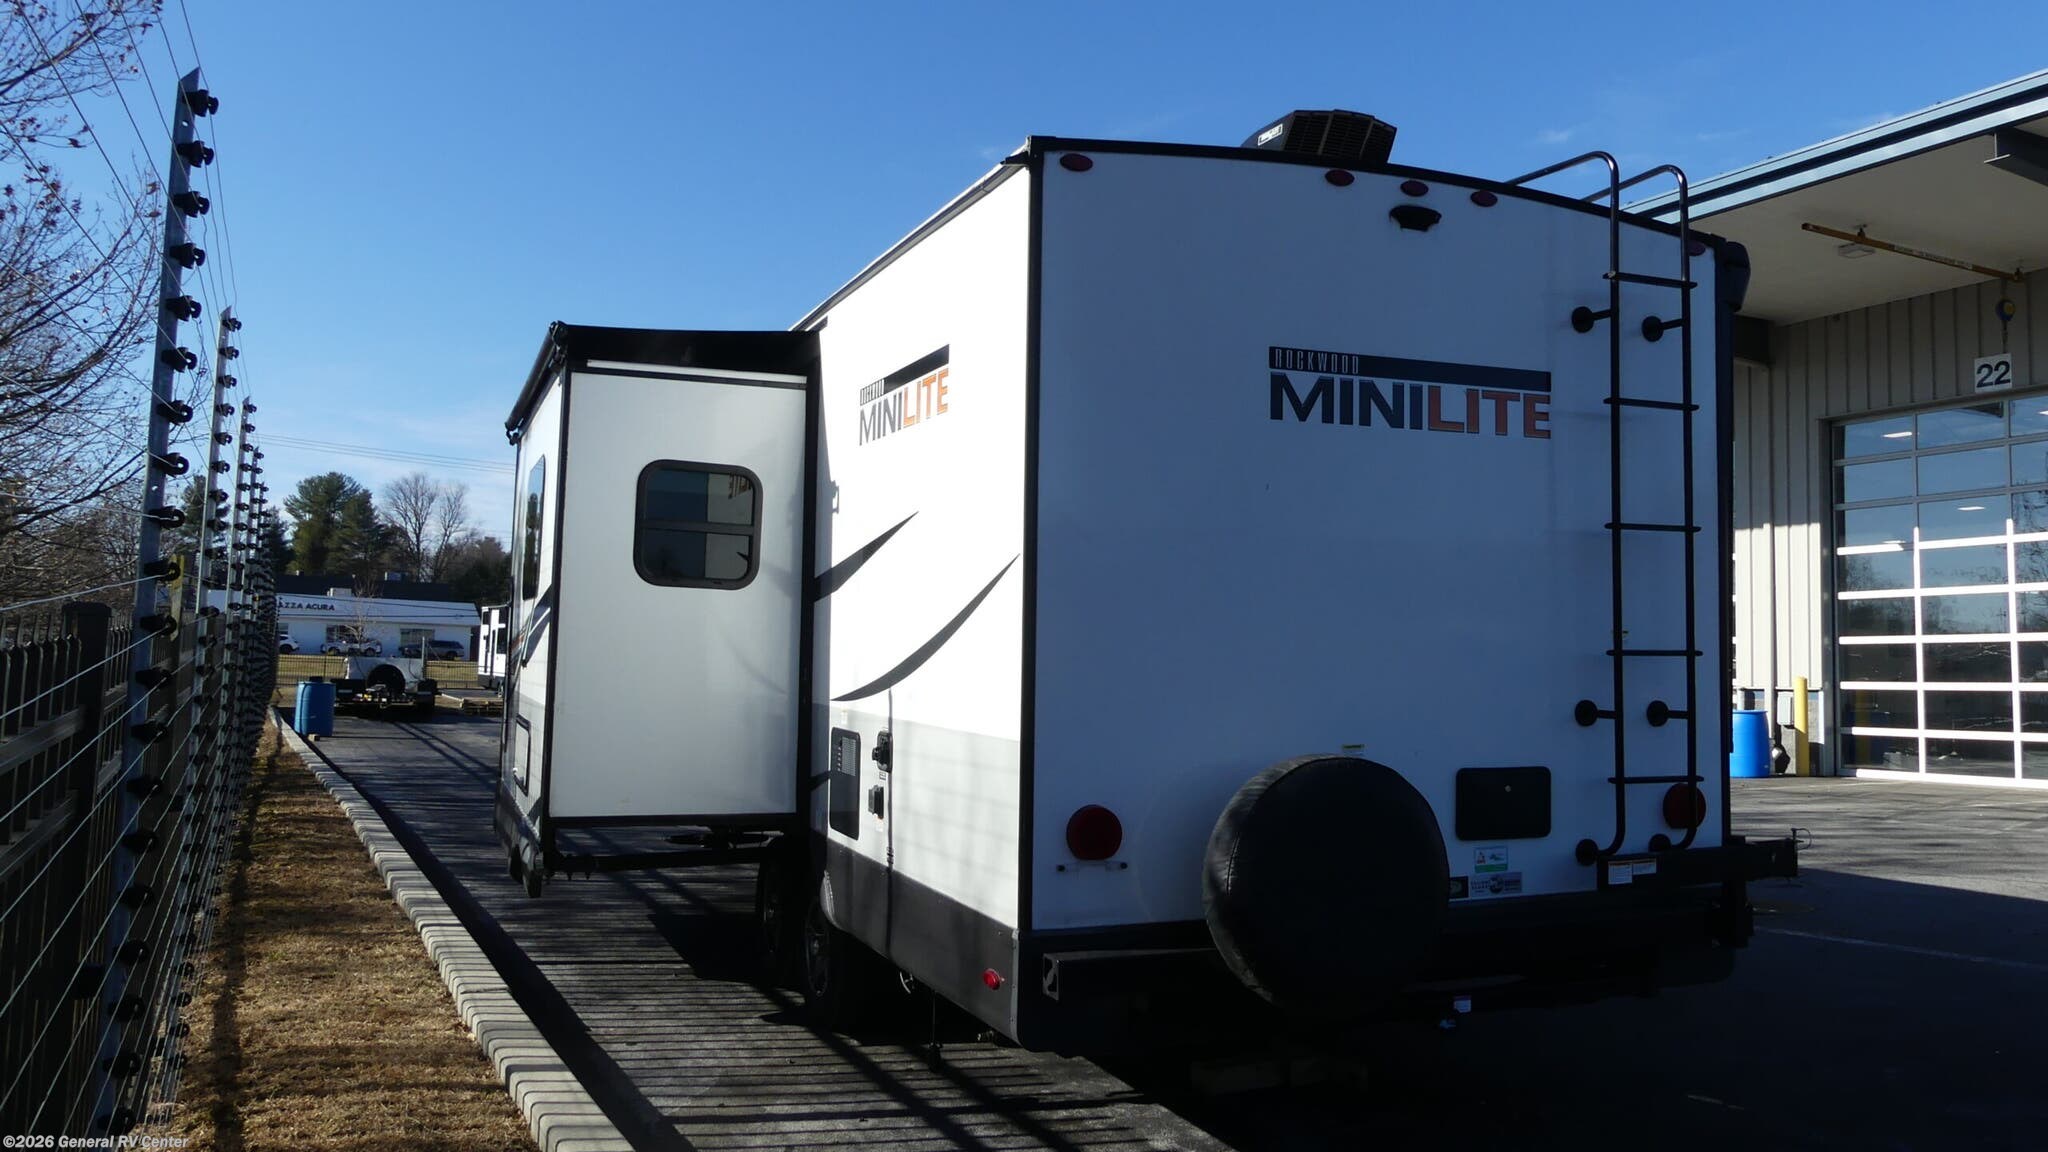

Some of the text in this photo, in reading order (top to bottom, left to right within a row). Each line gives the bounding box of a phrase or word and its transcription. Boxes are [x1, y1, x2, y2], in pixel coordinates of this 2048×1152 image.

[1275, 348, 1359, 375] ROCKWOOD
[1976, 361, 2011, 388] 22
[1270, 371, 1551, 439] MINILITE
[305, 603, 335, 611] ACURA
